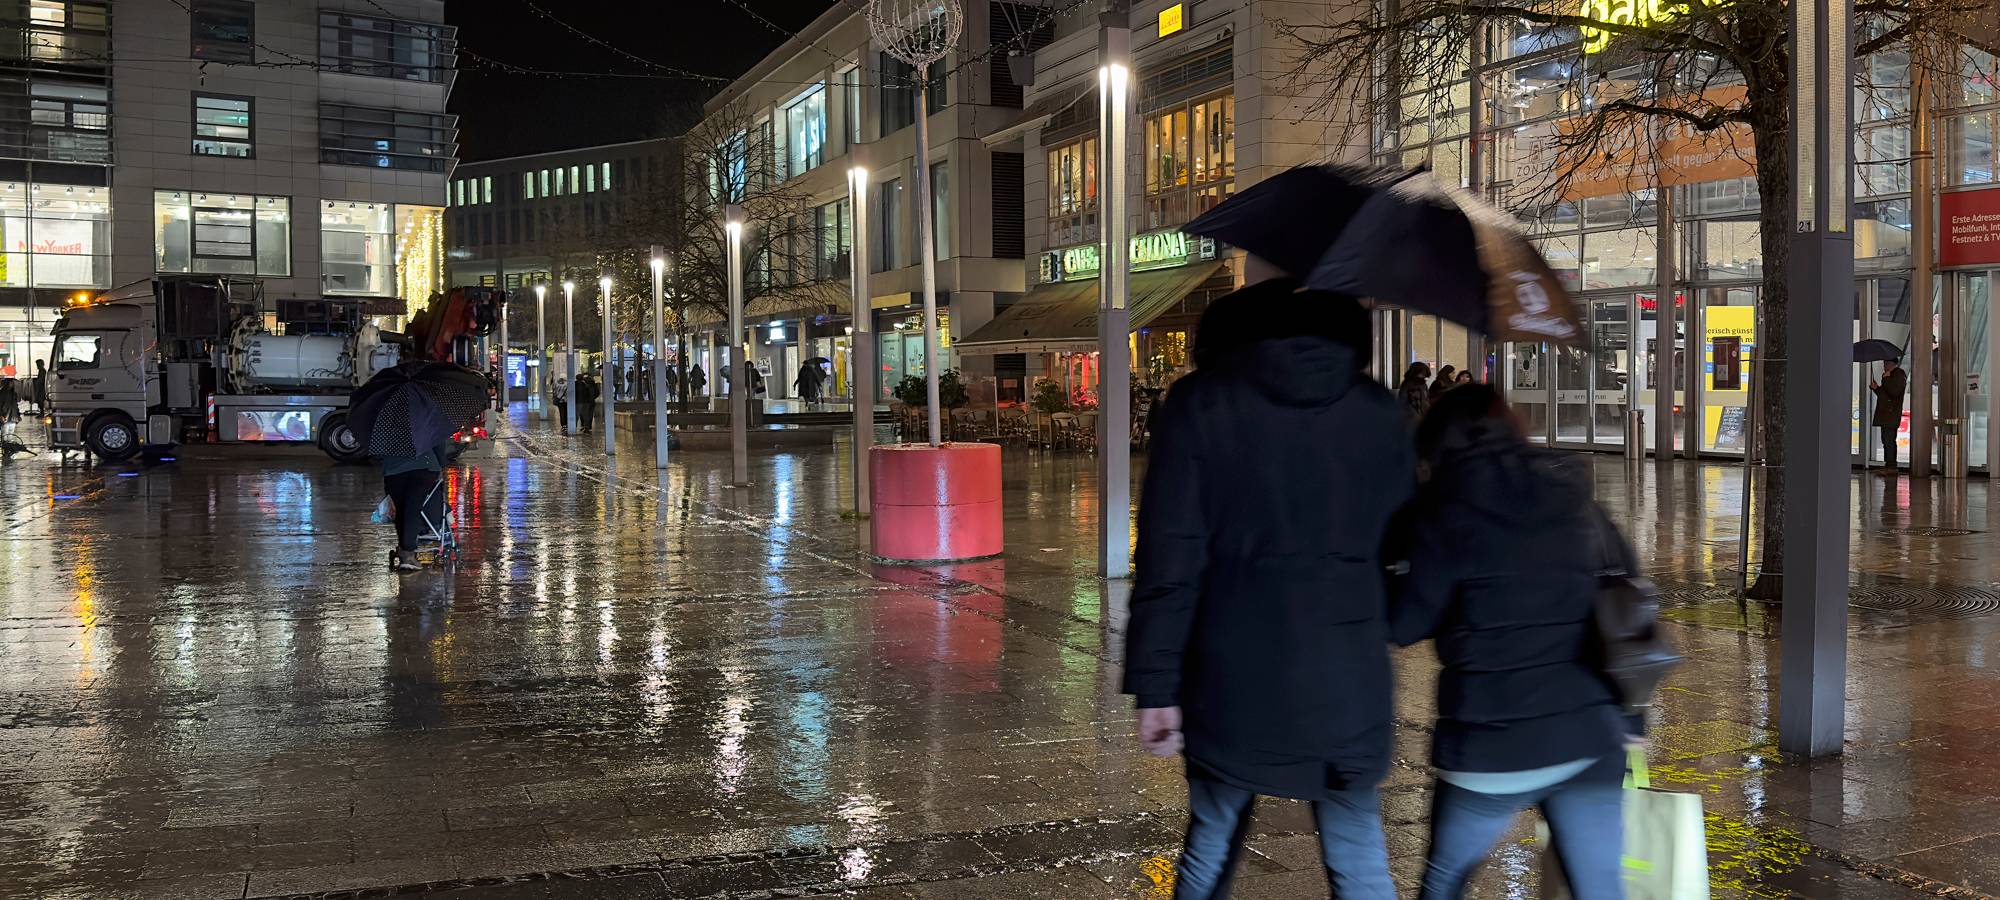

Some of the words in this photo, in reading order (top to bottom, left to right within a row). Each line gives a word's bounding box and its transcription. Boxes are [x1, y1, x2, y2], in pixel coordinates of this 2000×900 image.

[1972, 214, 2000, 222] Adresse
[1798, 221, 1811, 232] 21
[1952, 224, 1989, 234] Mobilfunk,
[1952, 234, 1982, 244] Festnetz
